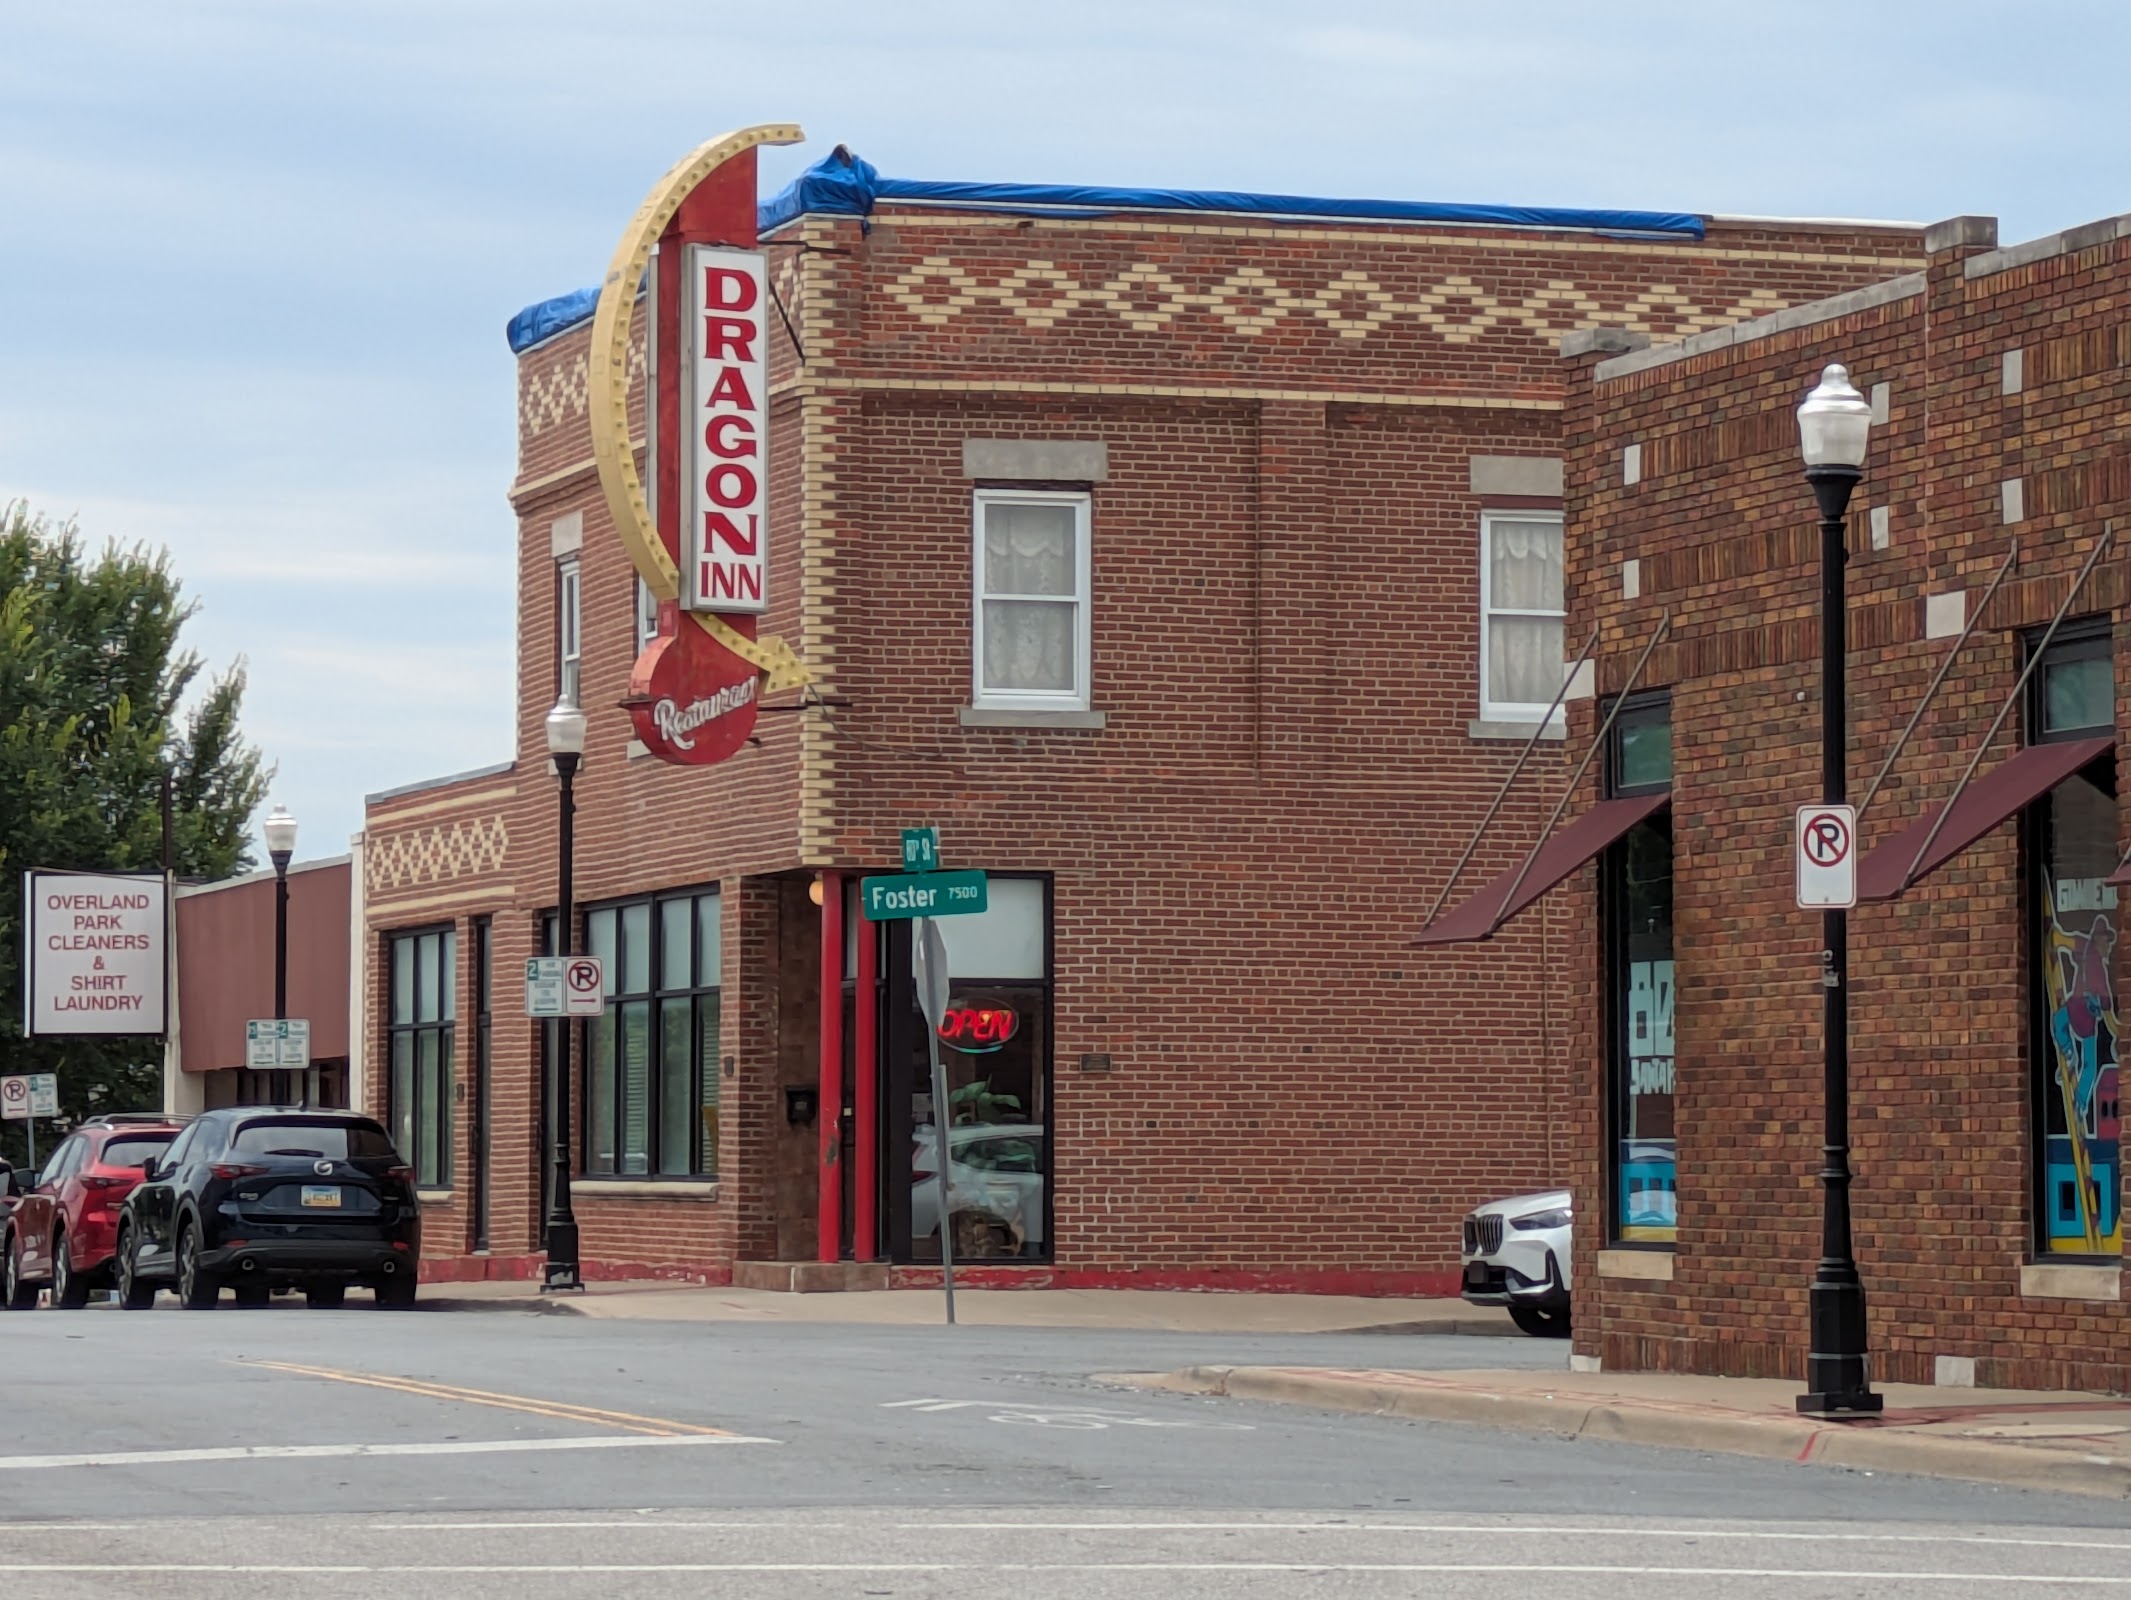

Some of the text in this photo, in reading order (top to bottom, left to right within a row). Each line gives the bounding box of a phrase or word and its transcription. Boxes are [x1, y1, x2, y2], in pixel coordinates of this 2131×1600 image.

[703, 266, 758, 556] DRAGON
[700, 561, 762, 600] INN
[47, 894, 150, 911] OVERLAND
[872, 885, 978, 910] Foster 7500
[73, 914, 124, 931] PARK
[48, 934, 150, 951] CLEANERS
[93, 955, 105, 971] &
[528, 961, 538, 977] 2
[71, 975, 128, 991] SHIRT
[53, 995, 143, 1011] LAUNDRY
[937, 1008, 1014, 1042] OPEN
